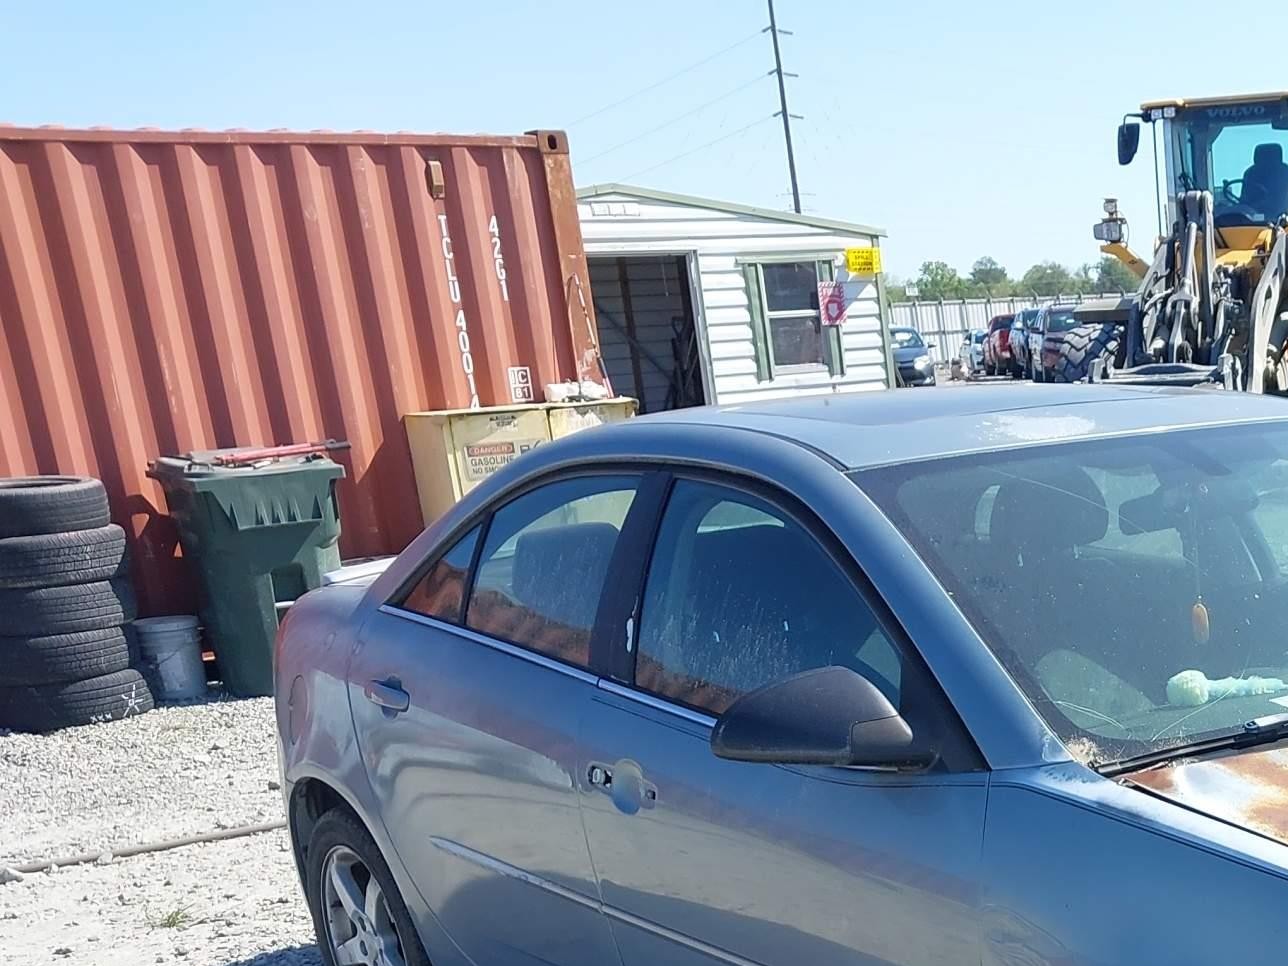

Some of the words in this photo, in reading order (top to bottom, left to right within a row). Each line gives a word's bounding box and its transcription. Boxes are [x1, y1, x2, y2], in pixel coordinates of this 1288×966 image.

[1207, 105, 1265, 118] VOLVO
[437, 215, 461, 303] TCLU
[488, 215, 509, 301] 42G1
[474, 444, 508, 454] DANGER
